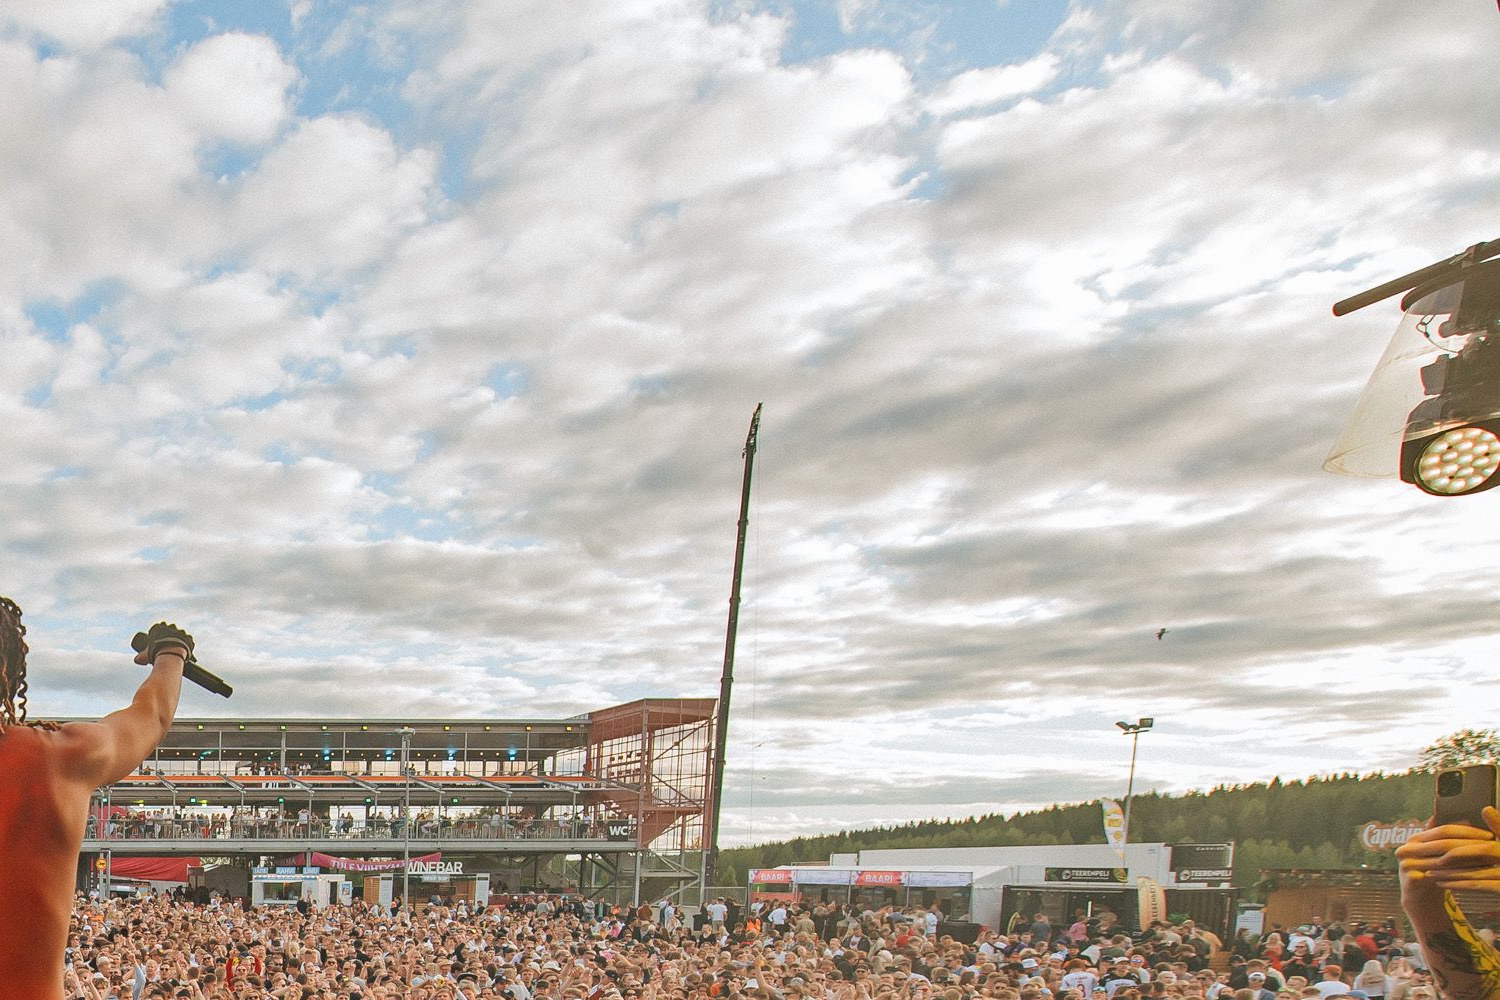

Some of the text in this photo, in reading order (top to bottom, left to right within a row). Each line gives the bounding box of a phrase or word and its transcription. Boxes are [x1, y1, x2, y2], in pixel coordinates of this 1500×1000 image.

[609, 825, 628, 836] WC
[761, 873, 785, 881] BAARI
[865, 874, 893, 882] BAARI
